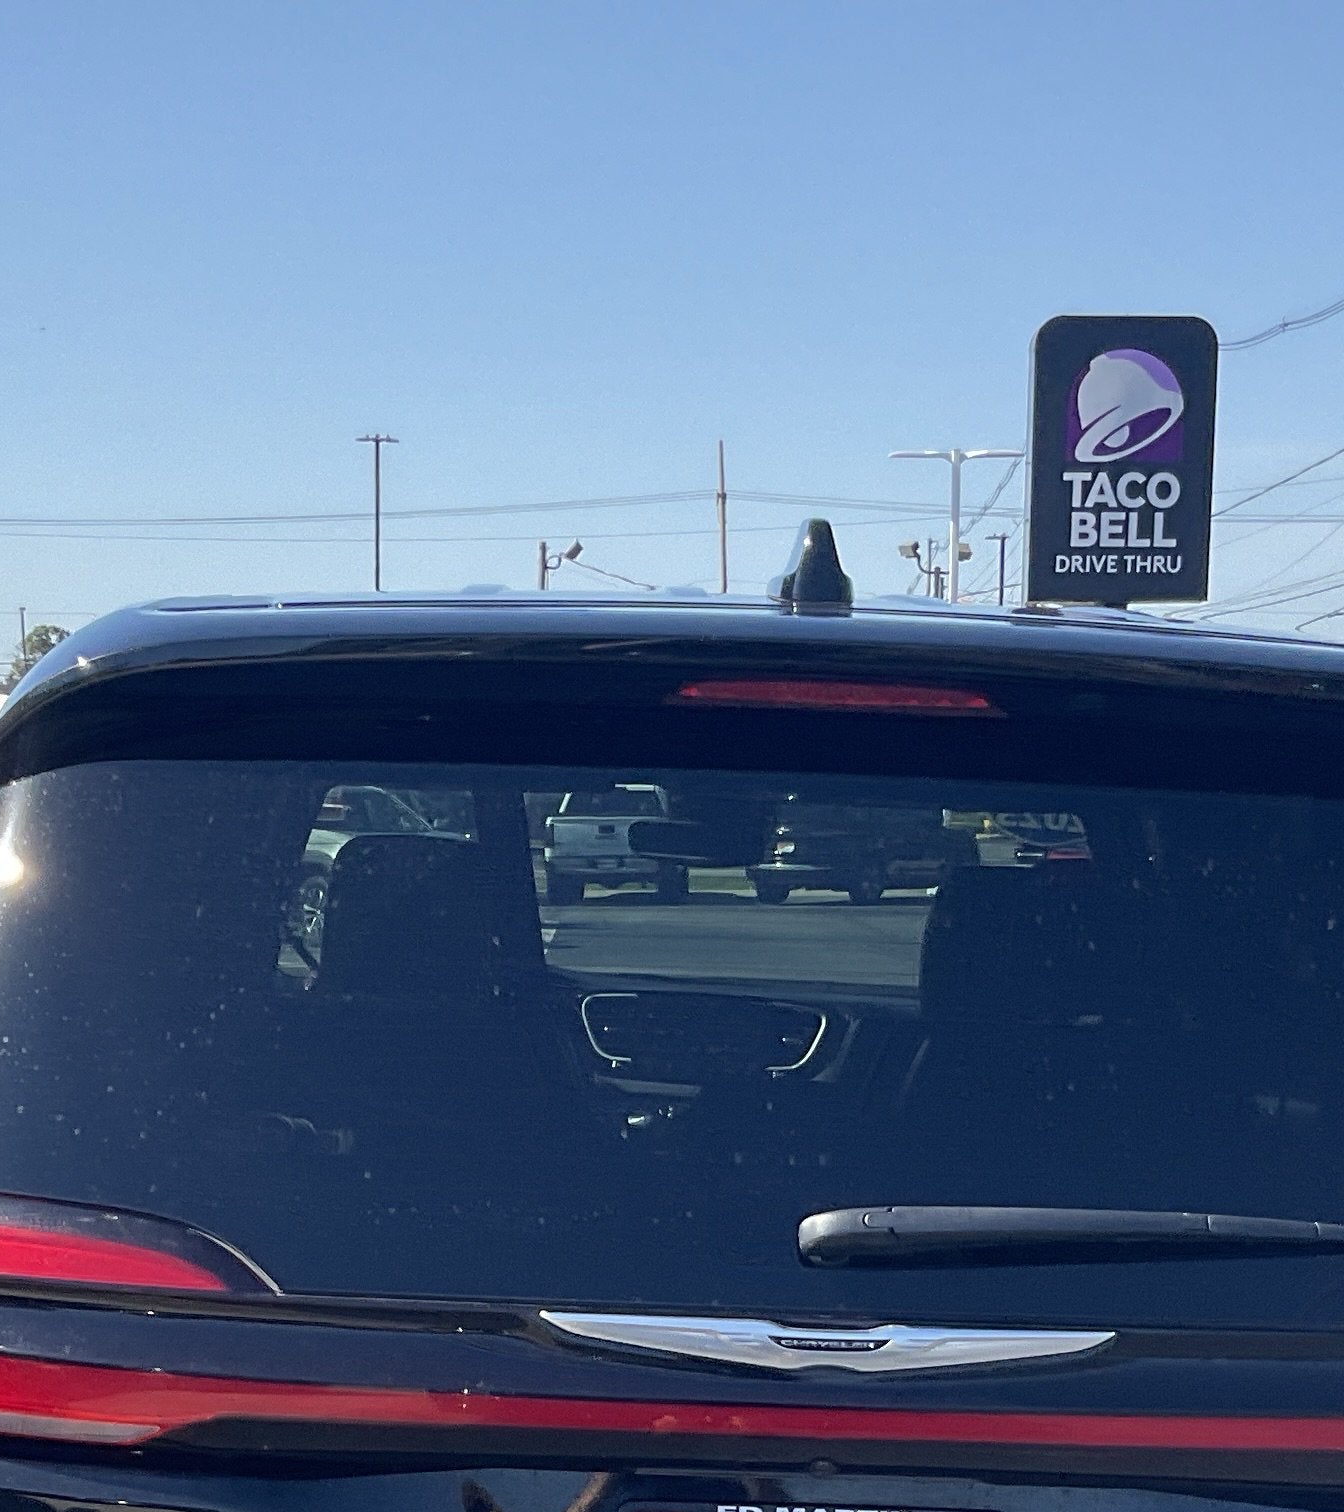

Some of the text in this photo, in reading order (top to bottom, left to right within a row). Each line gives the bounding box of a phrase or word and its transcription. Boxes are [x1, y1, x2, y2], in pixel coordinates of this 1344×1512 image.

[1062, 471, 1181, 509] TACO
[1069, 511, 1177, 548] BELL
[1055, 554, 1182, 574] DRIVE THRU
